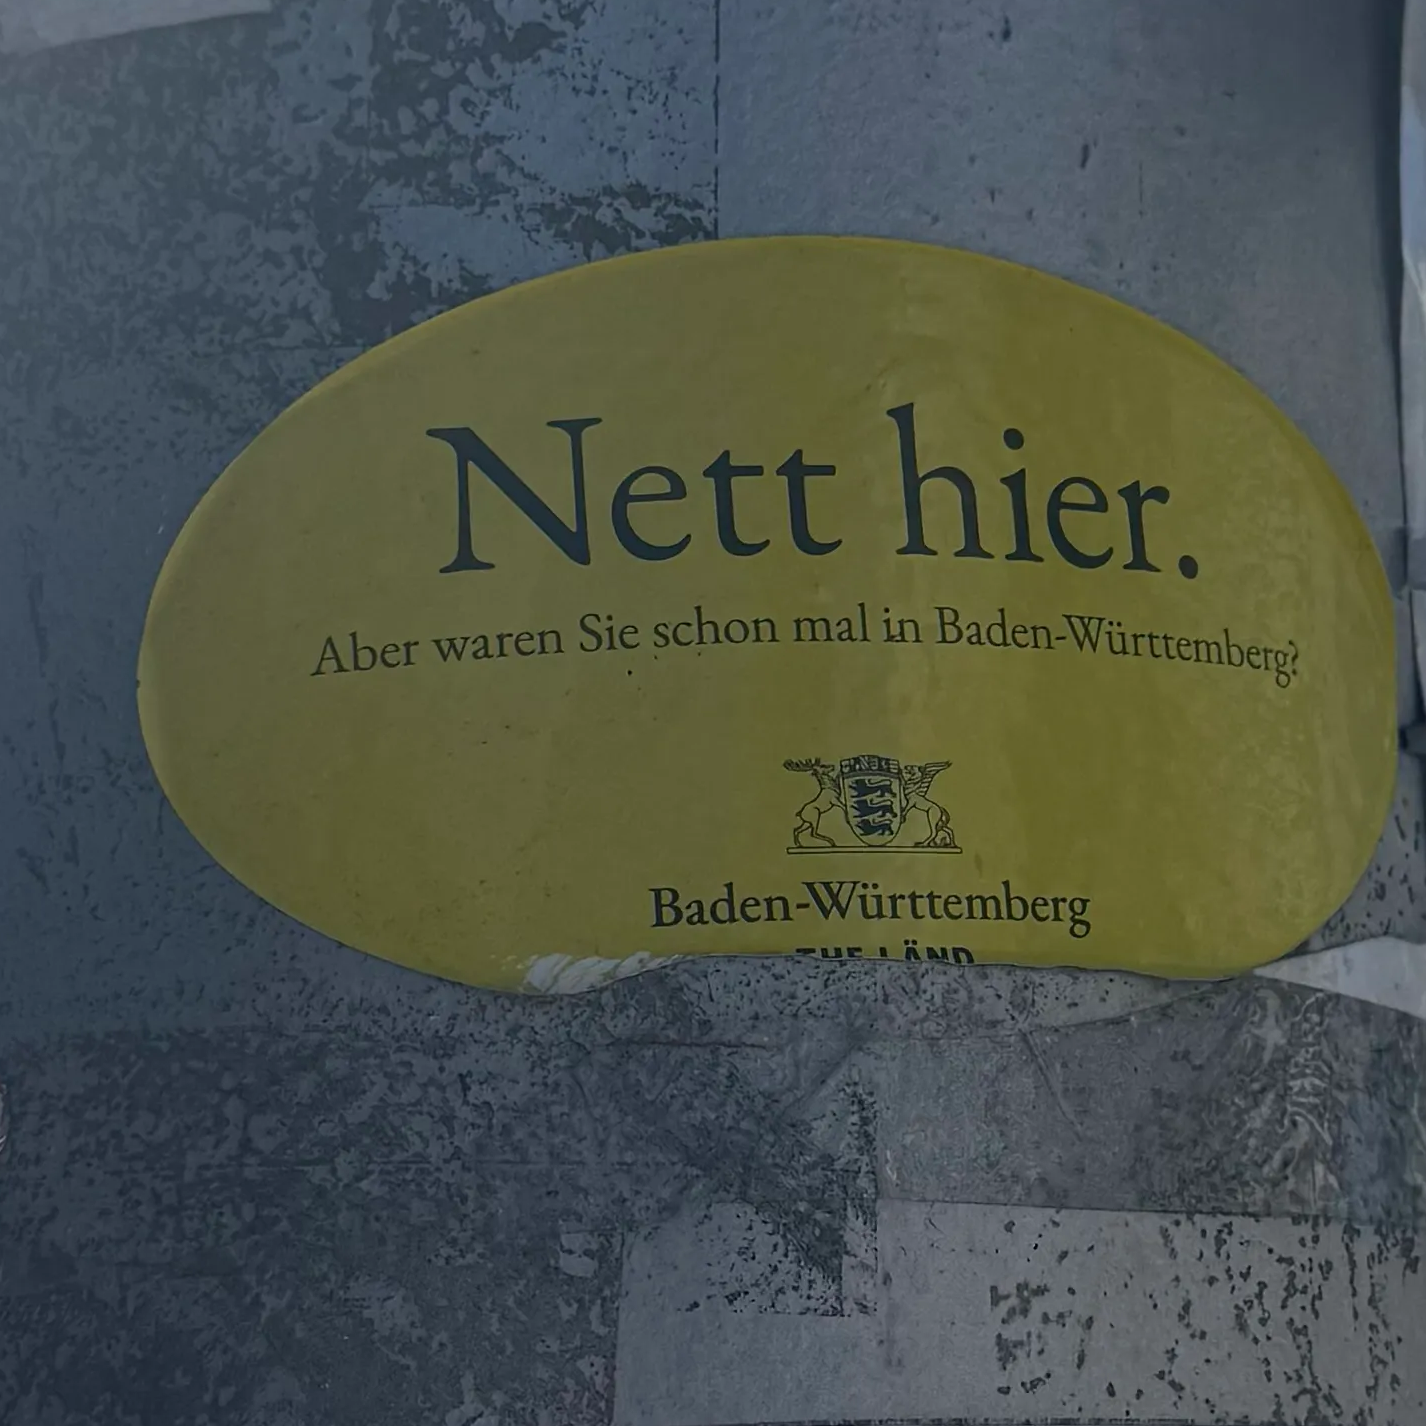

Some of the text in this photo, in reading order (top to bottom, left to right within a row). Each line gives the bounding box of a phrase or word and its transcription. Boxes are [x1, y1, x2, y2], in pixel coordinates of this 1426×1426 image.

[425, 401, 1200, 580] Nett hier.
[310, 602, 1300, 689] Aber waren Sie schon mal in Baden-Württemberg?
[648, 880, 1092, 939] Baden-Württemberg
